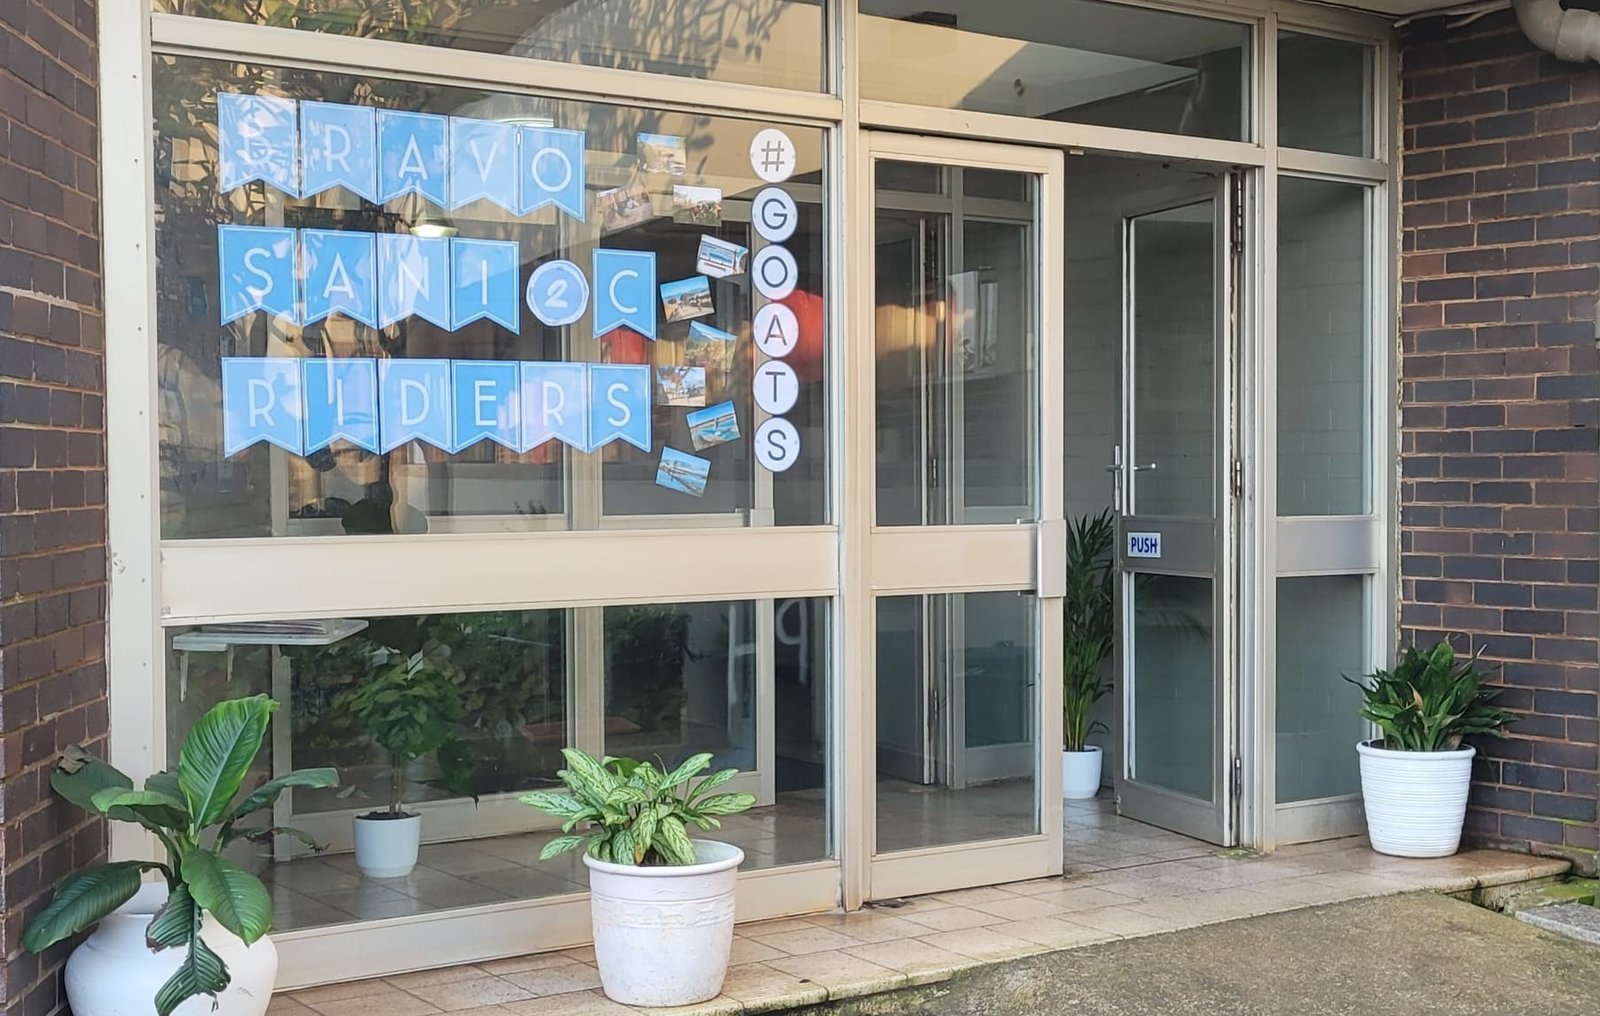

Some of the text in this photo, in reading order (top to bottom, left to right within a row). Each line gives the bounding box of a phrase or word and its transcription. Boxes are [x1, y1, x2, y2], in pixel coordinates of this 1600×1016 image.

[760, 140, 789, 462] #GOATS
[249, 378, 631, 428] RIDERS
[1131, 537, 1157, 553] PUSH
